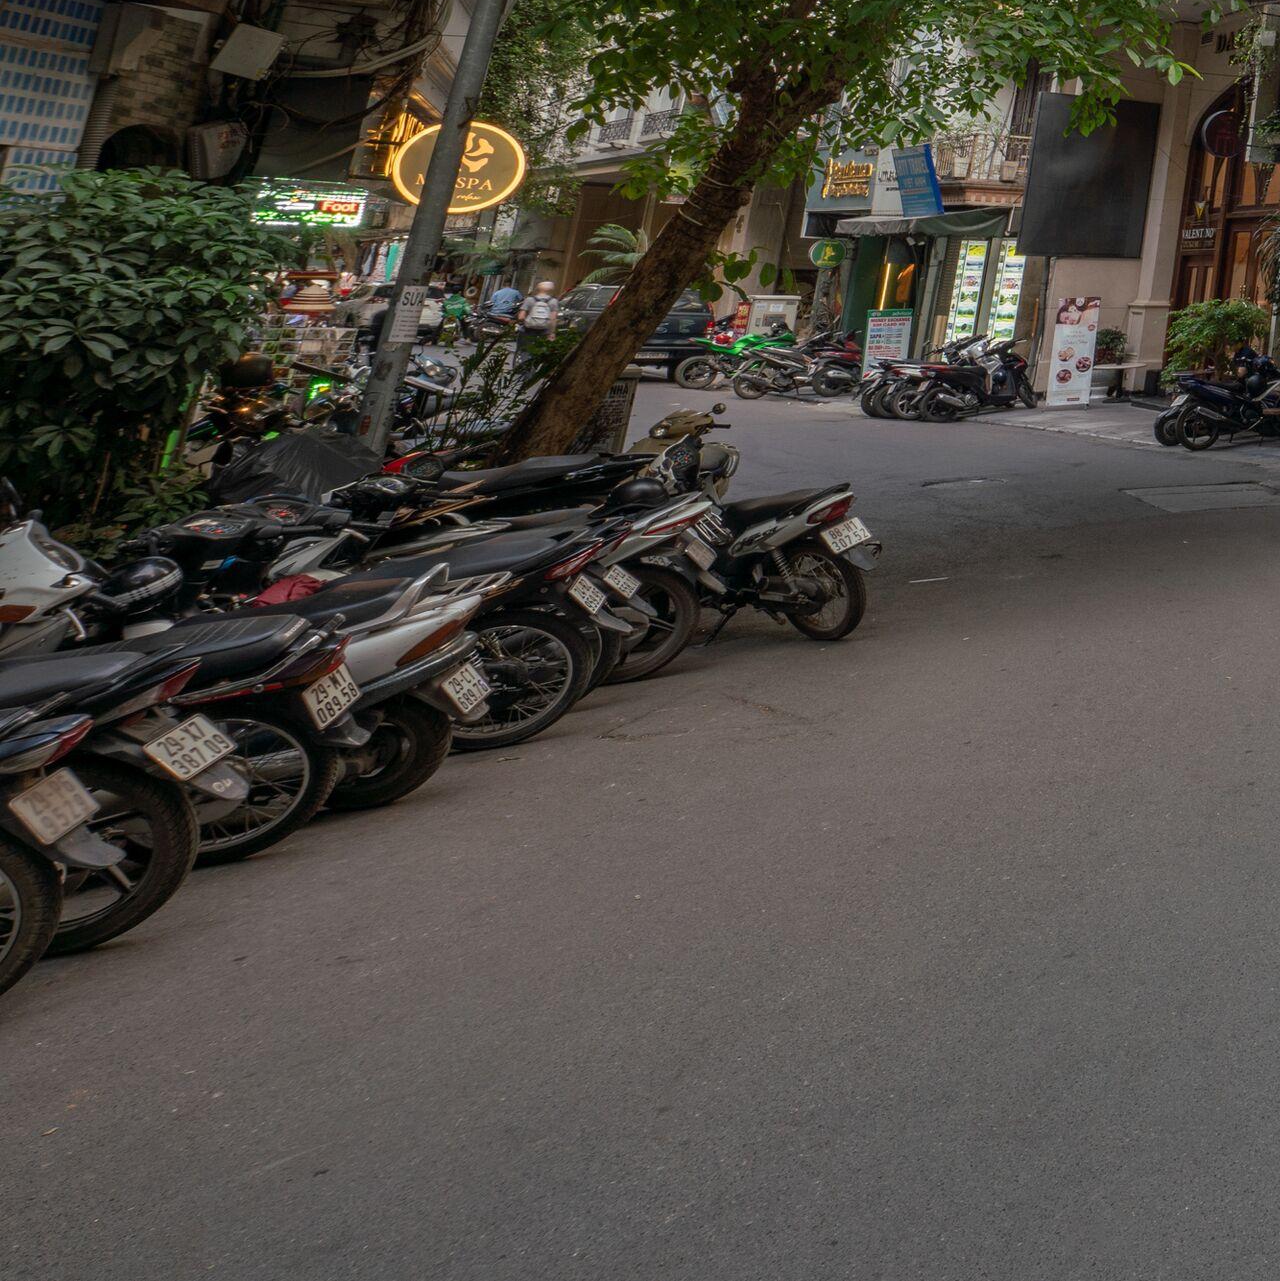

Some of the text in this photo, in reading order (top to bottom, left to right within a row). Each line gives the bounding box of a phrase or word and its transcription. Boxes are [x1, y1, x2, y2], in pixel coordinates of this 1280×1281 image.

[455, 176, 493, 191] SPA
[321, 201, 358, 212] Foot
[828, 520, 858, 540] 88-H1
[448, 668, 475, 694] 29-C1
[316, 682, 359, 723] 089.58
[157, 721, 206, 757] 29-X7
